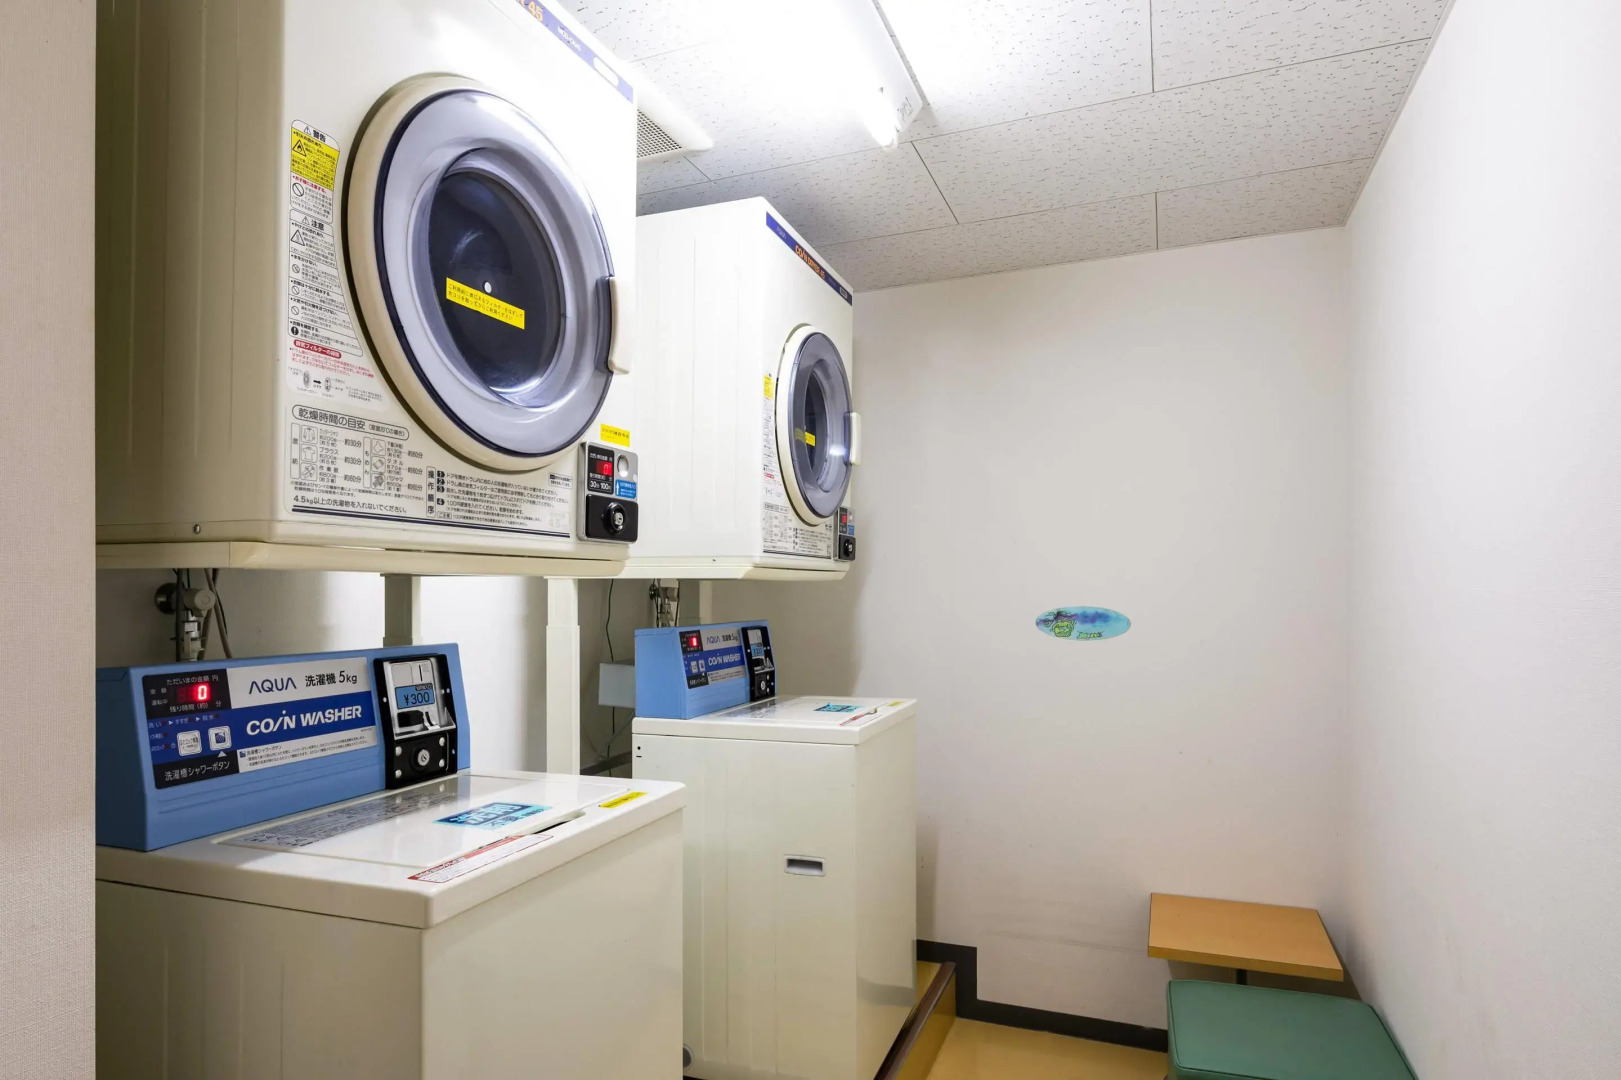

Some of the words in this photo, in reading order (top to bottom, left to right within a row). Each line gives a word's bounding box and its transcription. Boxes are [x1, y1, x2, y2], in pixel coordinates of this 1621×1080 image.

[298, 408, 366, 430] 乾燥時間の目安
[197, 684, 208, 700] 0
[248, 677, 297, 695] AQUA
[304, 673, 336, 688] 洗濯機
[338, 670, 358, 685] 5kg
[403, 691, 430, 706] ¥300
[300, 705, 362, 727] WASHER
[164, 761, 231, 782] 洗濯槽シャワーボタン
